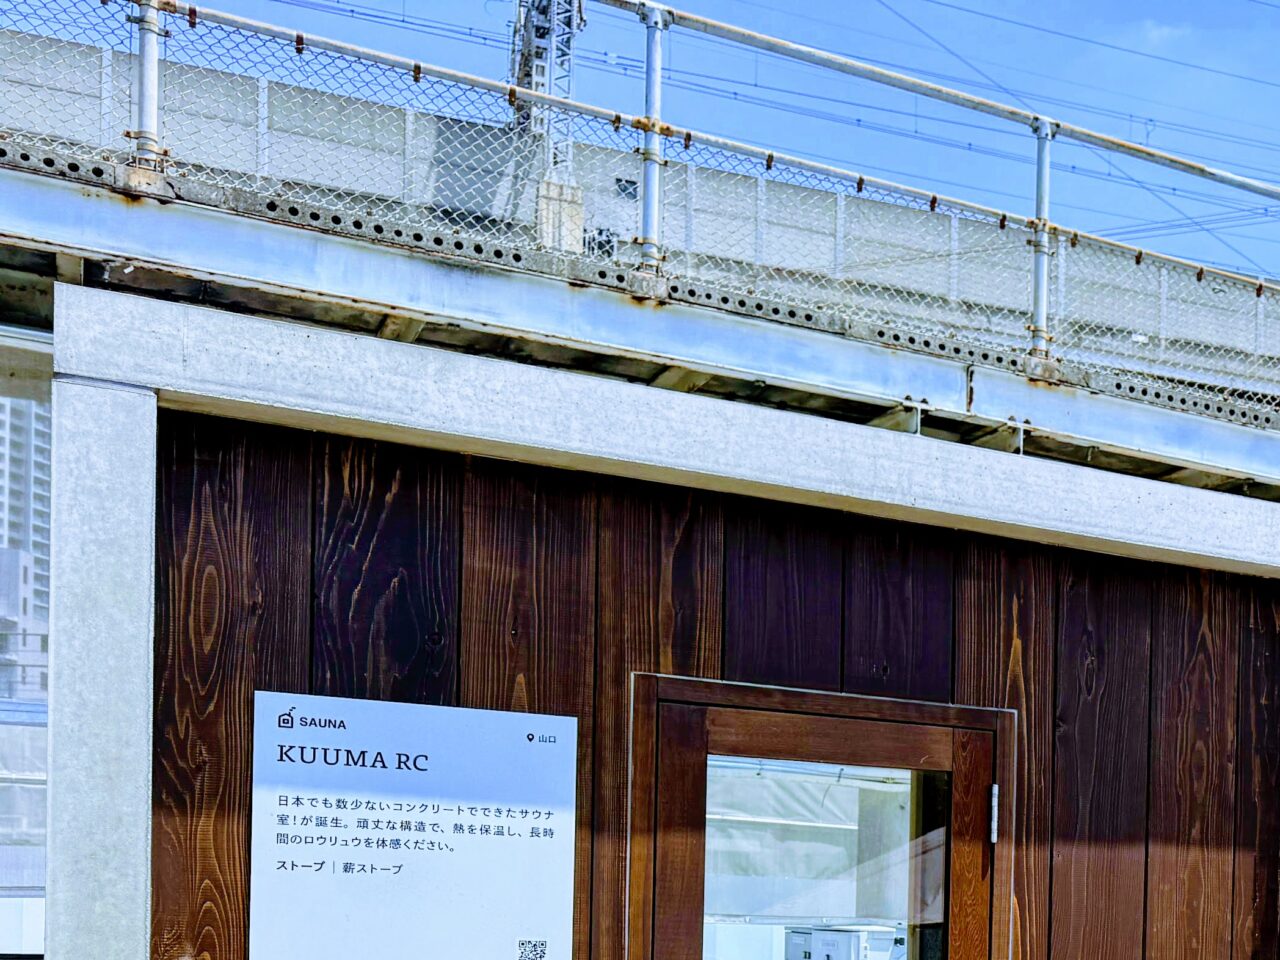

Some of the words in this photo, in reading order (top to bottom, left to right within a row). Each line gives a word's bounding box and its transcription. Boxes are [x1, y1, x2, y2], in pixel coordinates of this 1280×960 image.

[299, 716, 347, 730] SAUNA
[538, 734, 557, 744] 山口
[277, 744, 389, 769] KUUMA
[395, 752, 429, 772] RC
[278, 794, 555, 821] 日本でも数少ないコンクリートでできたサウナ
[276, 832, 455, 853] 間のロウリュウを体感ください。
